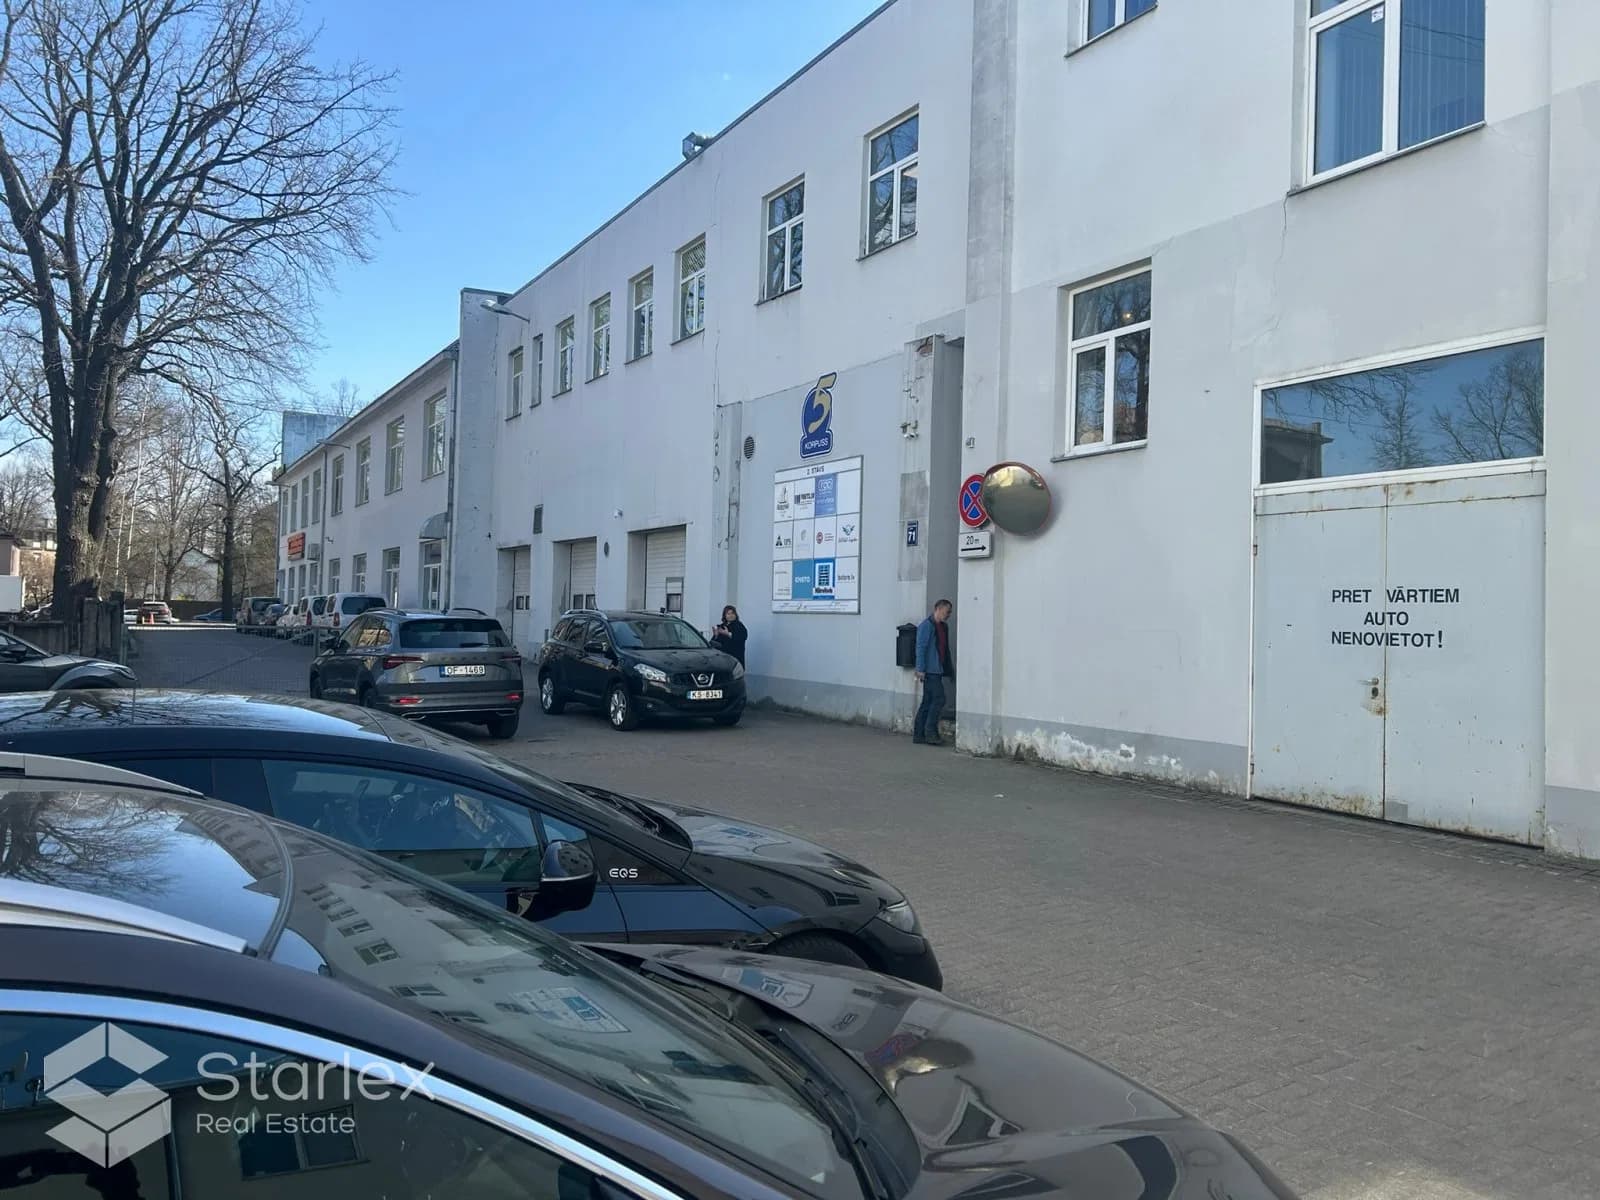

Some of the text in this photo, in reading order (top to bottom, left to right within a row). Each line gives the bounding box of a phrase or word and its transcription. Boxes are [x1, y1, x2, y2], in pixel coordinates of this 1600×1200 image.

[966, 535, 974, 545] 20
[1331, 586, 1460, 603] PRET VĀRTIEM
[1363, 611, 1409, 626] AUTO
[609, 868, 639, 879] EQS
